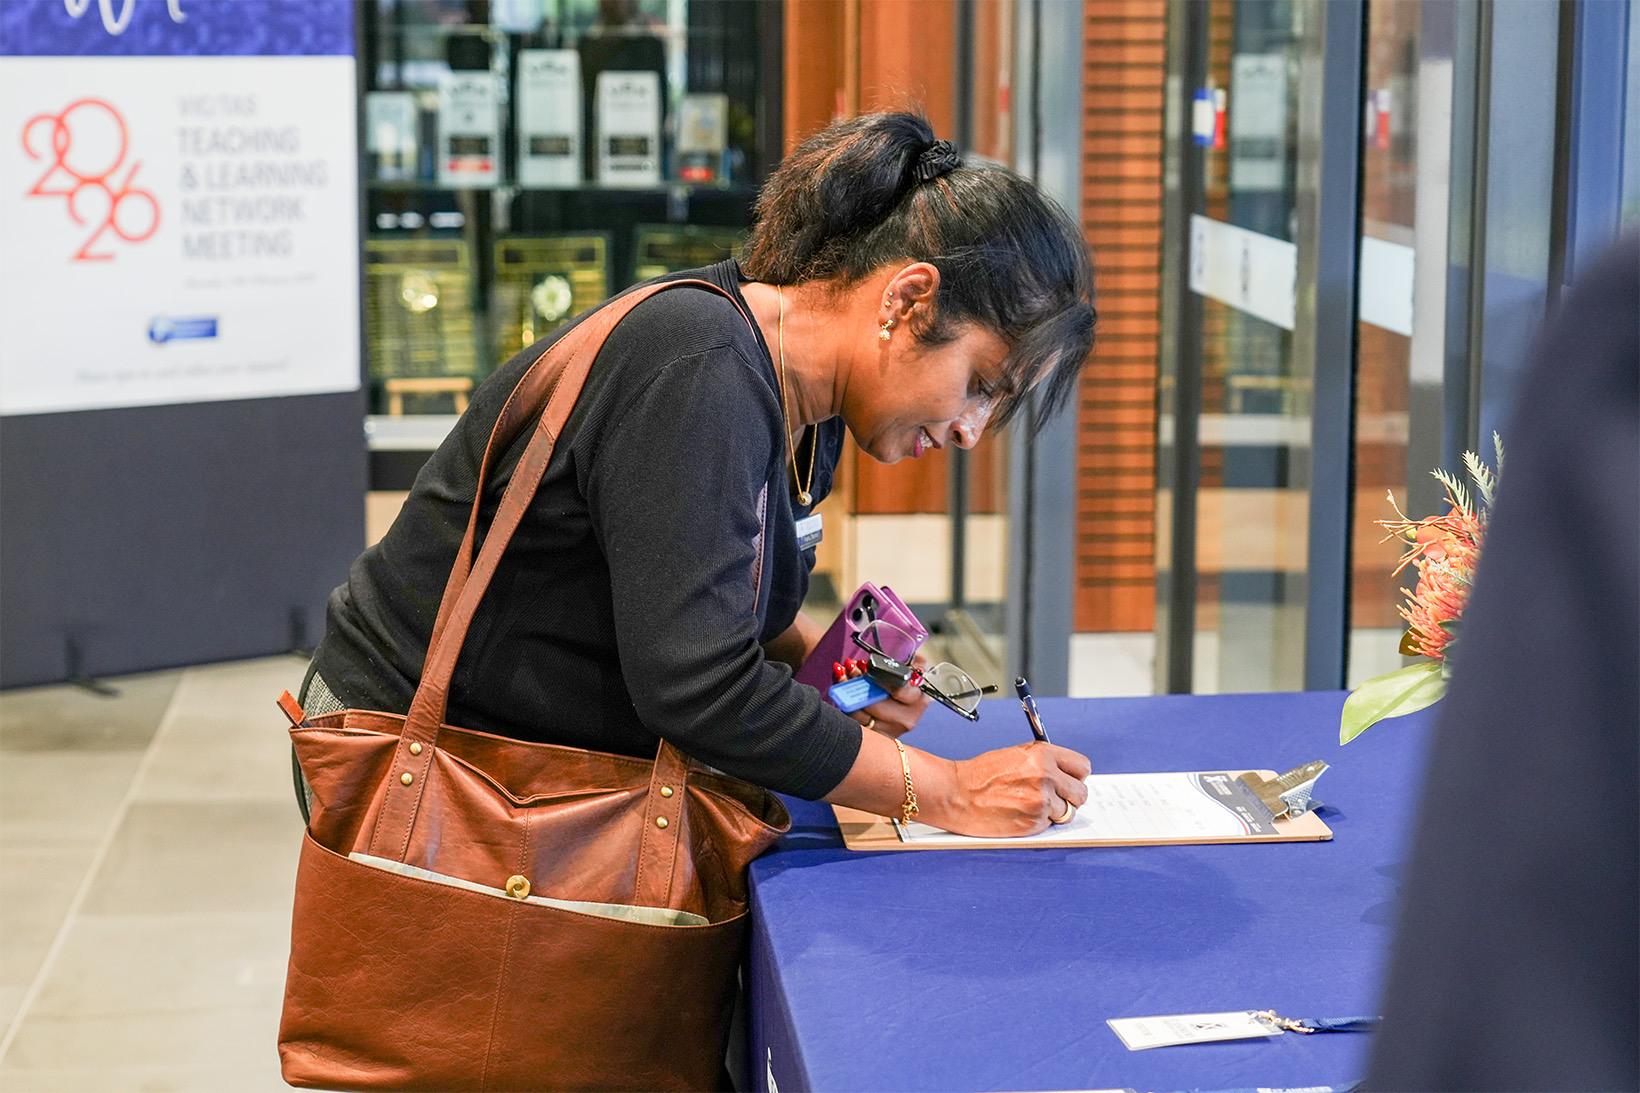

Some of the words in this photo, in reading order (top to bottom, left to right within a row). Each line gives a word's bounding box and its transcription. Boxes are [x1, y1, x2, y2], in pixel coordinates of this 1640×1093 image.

[177, 125, 299, 155] TEACHING
[180, 162, 199, 191] &
[204, 159, 328, 190] LEARNING
[181, 195, 306, 225] NETWORK
[182, 229, 293, 260] MEETING
